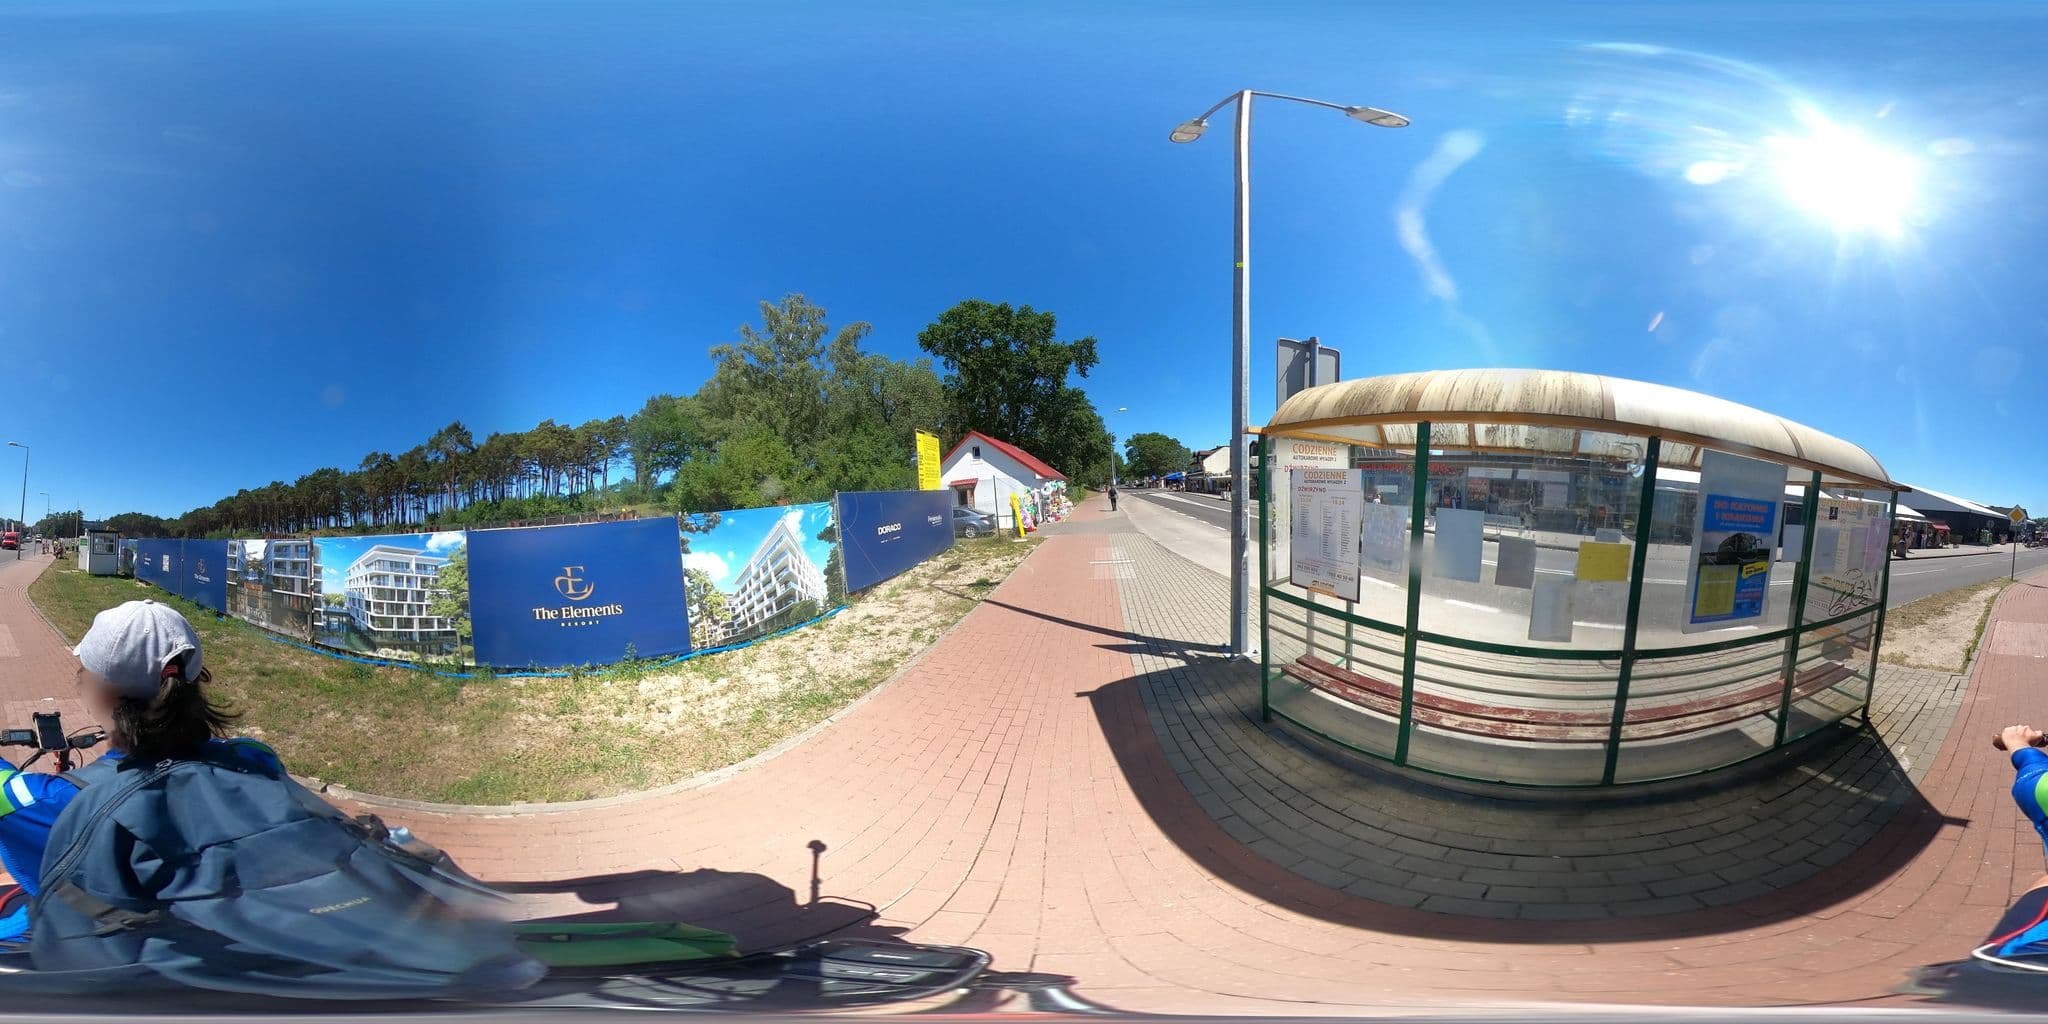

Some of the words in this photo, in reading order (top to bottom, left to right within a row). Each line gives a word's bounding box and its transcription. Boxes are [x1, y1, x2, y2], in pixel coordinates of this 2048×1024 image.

[1292, 443, 1337, 456] CODZIENNE
[1303, 471, 1347, 480] CODZIENNE
[532, 608, 559, 620] The
[561, 603, 623, 619] Elements
